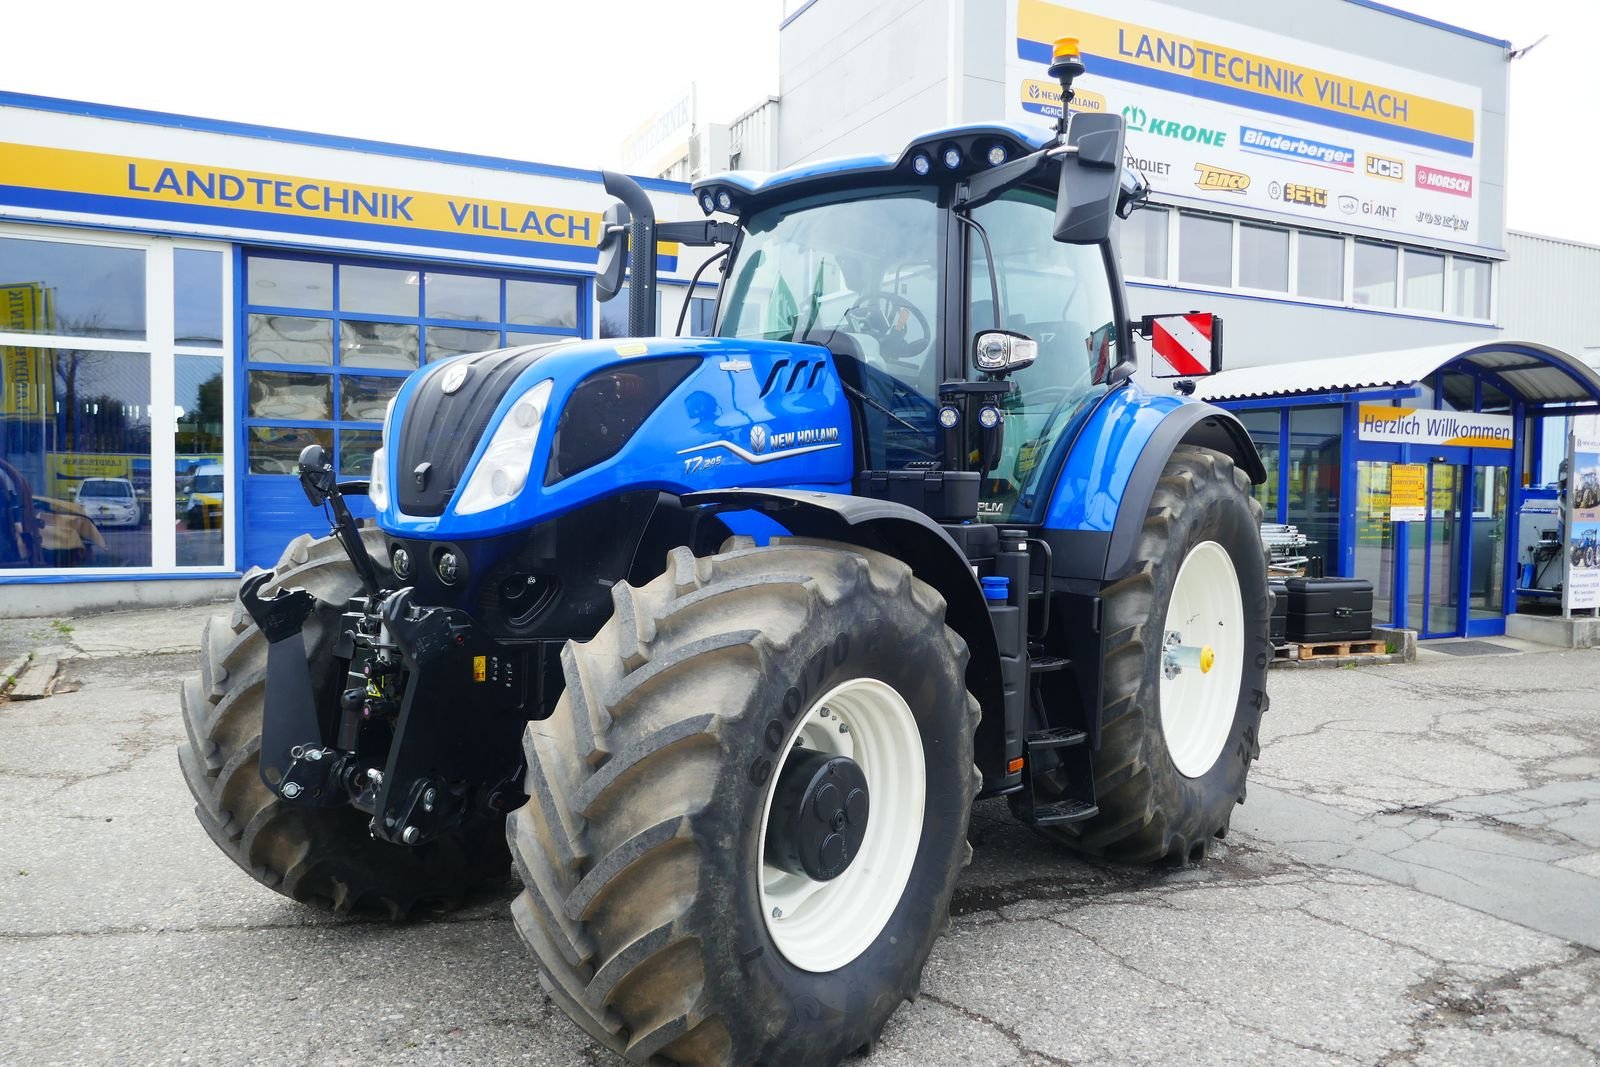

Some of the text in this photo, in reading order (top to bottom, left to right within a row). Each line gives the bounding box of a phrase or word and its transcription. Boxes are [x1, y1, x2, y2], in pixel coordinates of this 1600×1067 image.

[1117, 28, 1409, 122] LANDTECHNIK VILLACH
[1148, 117, 1227, 148] KRONE
[1243, 129, 1352, 163] Binderberger
[1124, 155, 1171, 175] RIOLIET
[1194, 162, 1251, 191] Tanco
[1367, 156, 1403, 180] JCB
[1427, 172, 1471, 193] HORSCH
[128, 163, 590, 241] LANDTECHNIK VILLACH
[770, 427, 839, 451] NEW HOLLAND
[1363, 413, 1510, 441] Herzlich Willkommen
[977, 502, 1004, 512] PLM
